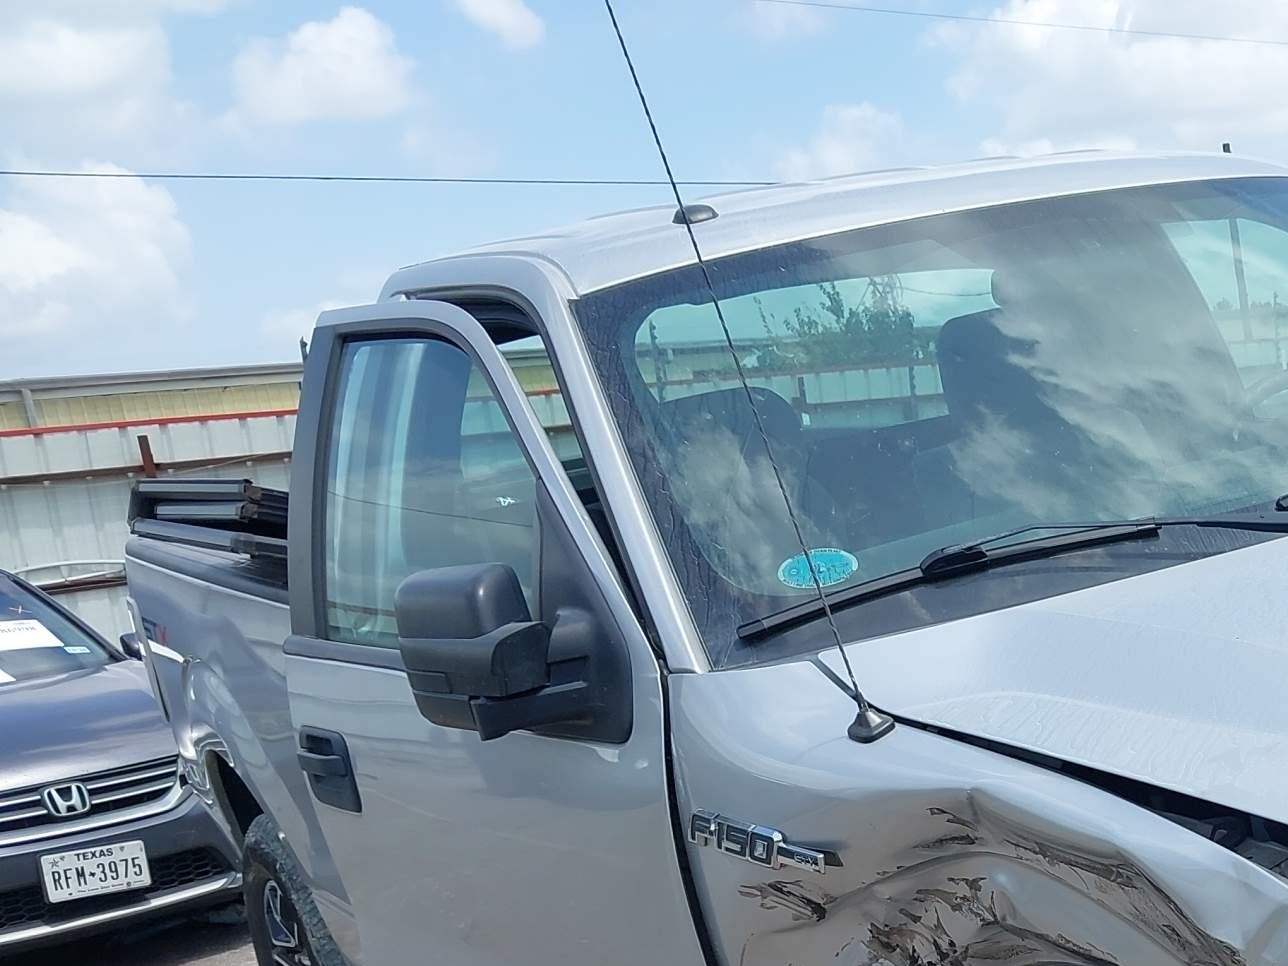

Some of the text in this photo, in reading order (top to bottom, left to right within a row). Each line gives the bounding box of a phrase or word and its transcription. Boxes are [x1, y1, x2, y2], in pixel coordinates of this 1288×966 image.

[688, 808, 779, 870] F150
[74, 847, 114, 862] TEXAS
[96, 856, 143, 883] 3975
